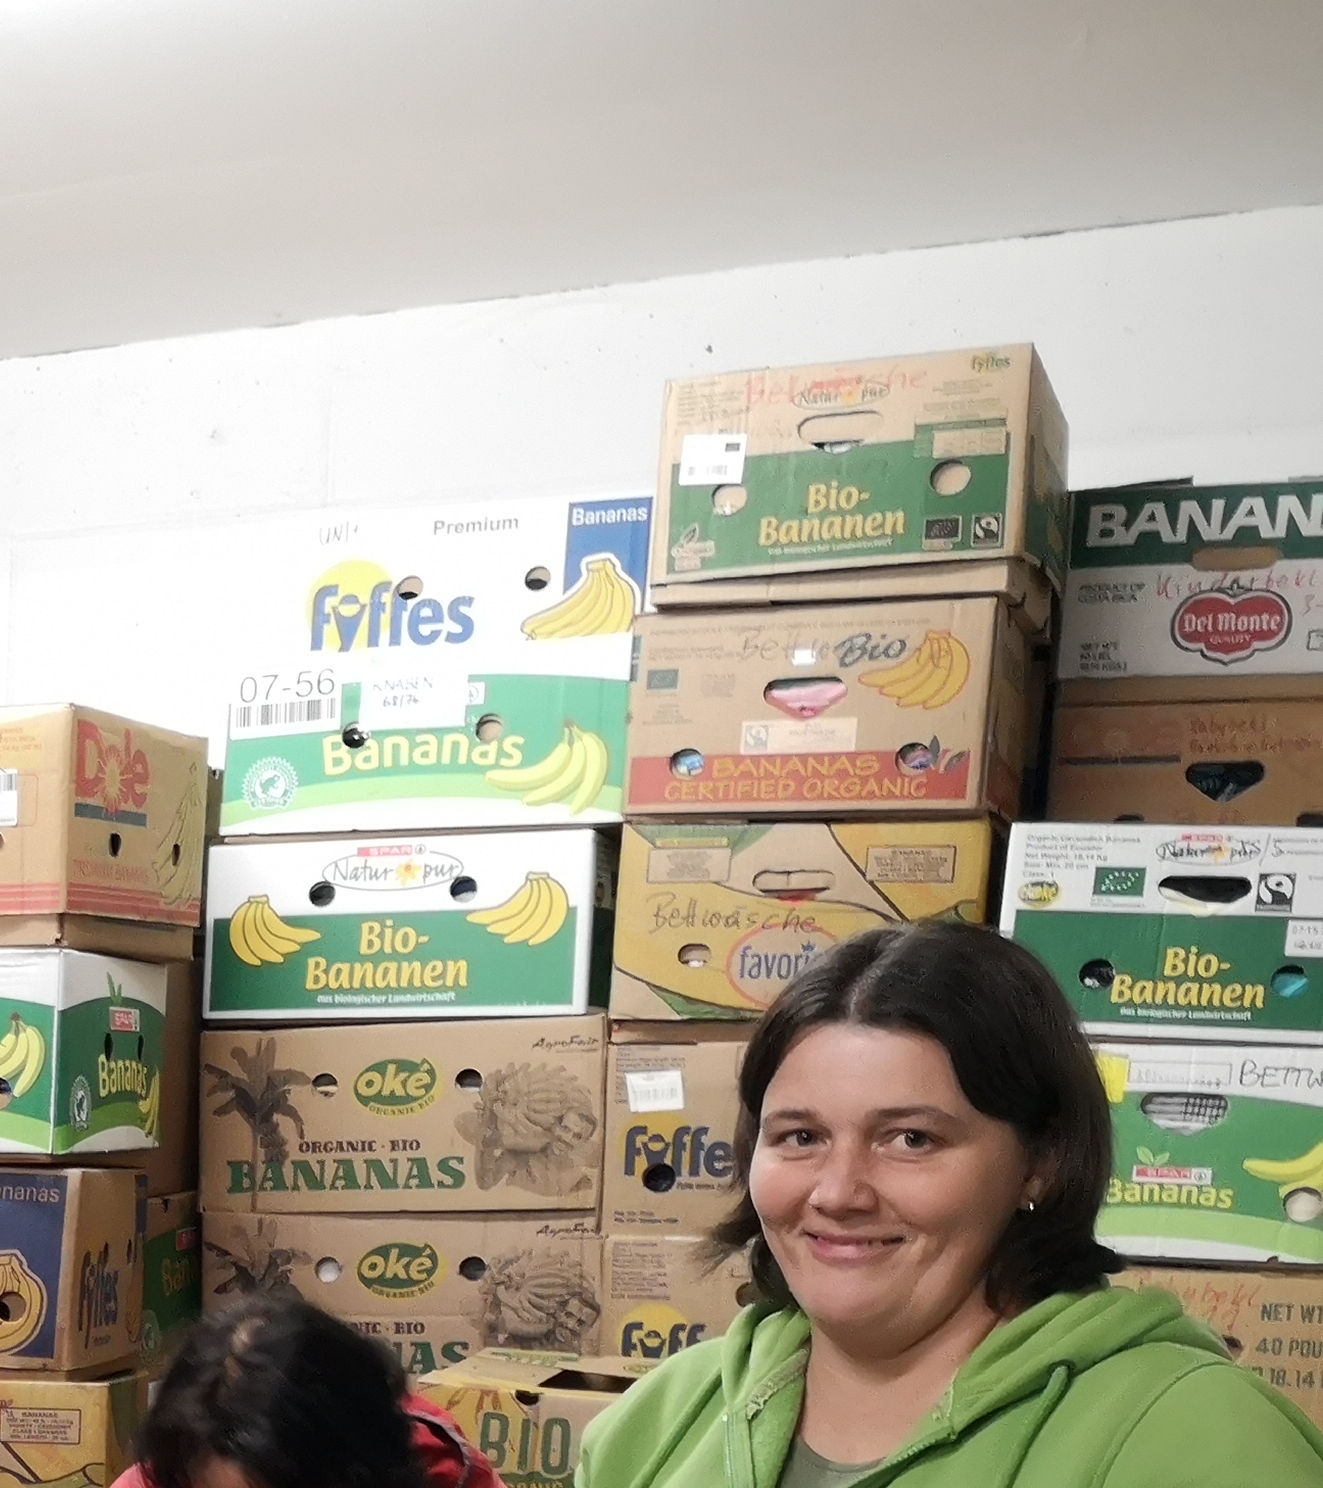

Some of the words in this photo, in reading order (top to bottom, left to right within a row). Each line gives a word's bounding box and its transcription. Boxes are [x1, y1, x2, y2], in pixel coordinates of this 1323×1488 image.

[571, 503, 649, 527] Bananas
[807, 480, 870, 515] Bio-
[433, 515, 519, 536] Premium
[758, 508, 905, 547] Bananen
[309, 579, 475, 653] fyffes
[1182, 612, 1213, 632] Del
[1218, 611, 1282, 632] Monte
[834, 632, 909, 669] Bio
[74, 717, 150, 814] Dole
[322, 729, 527, 777] Bananas
[712, 755, 881, 778] BANANAS
[663, 778, 796, 802] CERTIFIED
[803, 775, 927, 800] ORGANIC
[331, 860, 395, 883] Natur
[422, 864, 459, 883] pur
[359, 918, 430, 957] Bio-
[305, 955, 469, 991] Bananen
[739, 946, 810, 981] favor
[1163, 944, 1232, 979] Bio-
[1110, 973, 1266, 1010] Bananen
[98, 1053, 149, 1100] Bananas
[355, 1060, 434, 1098] oké
[298, 1139, 376, 1154] ORGANIC
[389, 1138, 421, 1153] BIO
[623, 1125, 735, 1178] fyffe
[226, 1155, 467, 1195] BANANAS
[1105, 1176, 1235, 1210] Bananas
[359, 1244, 438, 1282] oké
[394, 1320, 426, 1335] BIO
[1260, 1302, 1294, 1322] NET
[1256, 1337, 1283, 1356] 40
[480, 1410, 572, 1478] BIO
